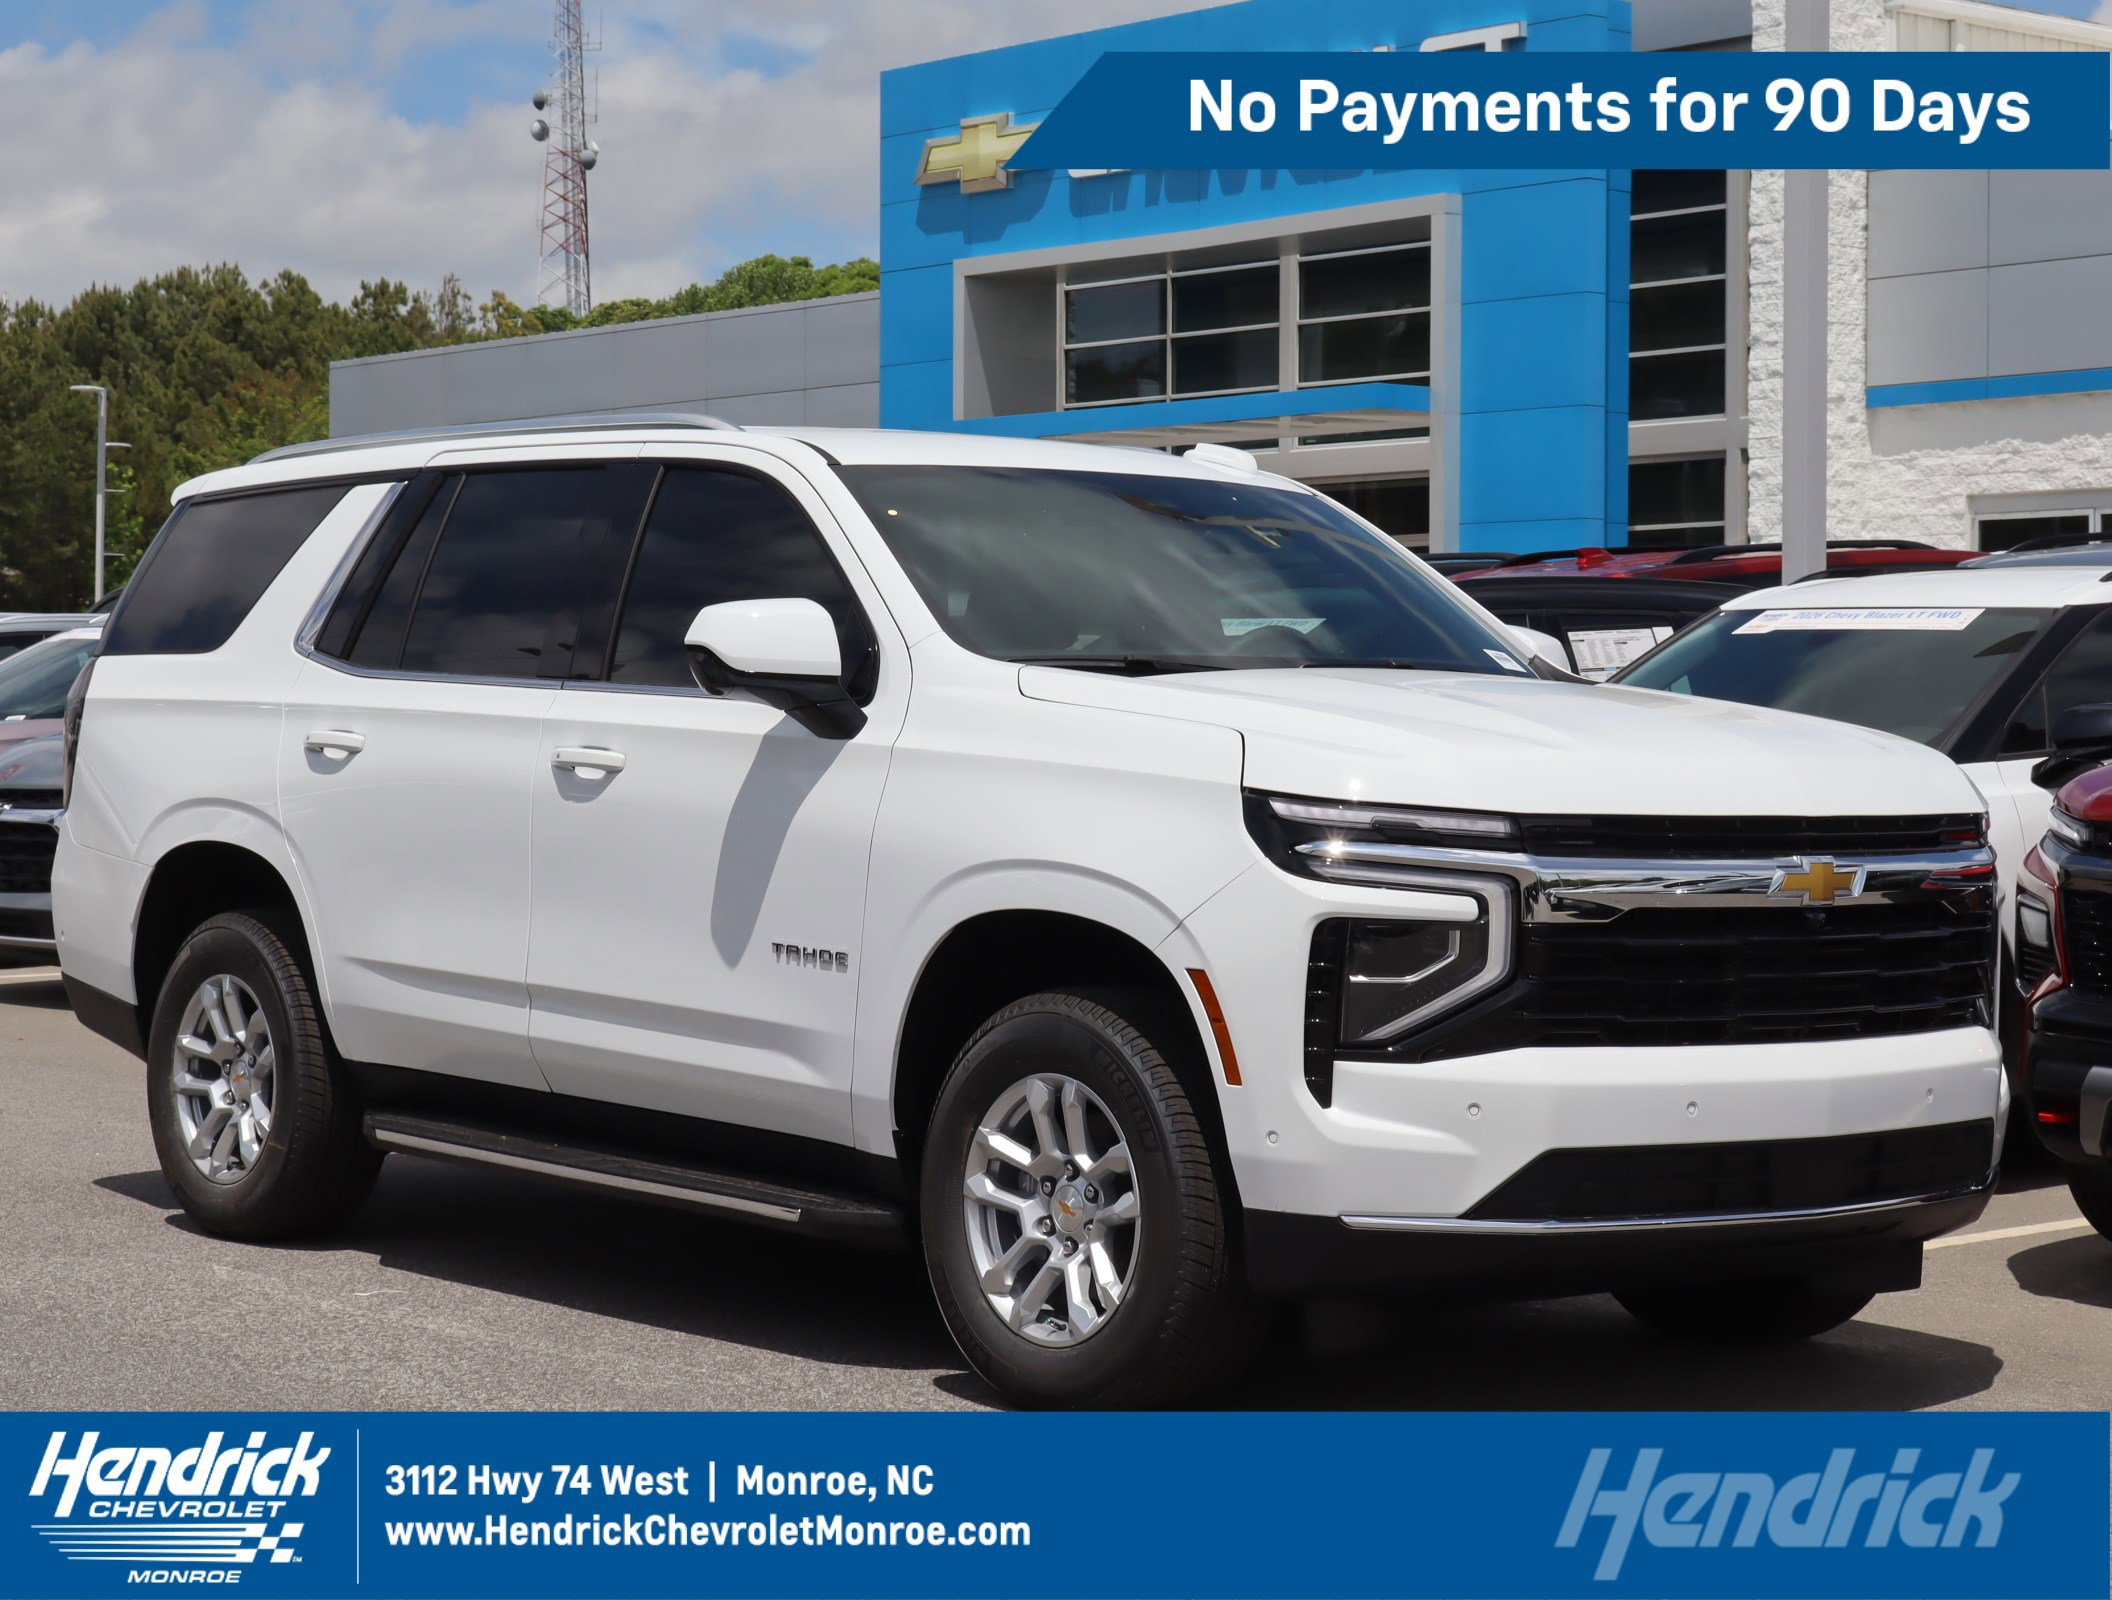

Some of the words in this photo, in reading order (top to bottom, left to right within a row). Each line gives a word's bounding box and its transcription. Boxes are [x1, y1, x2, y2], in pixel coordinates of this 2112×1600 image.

[1824, 611, 1862, 620] Chevy
[1863, 611, 1905, 619] Blazer
[1906, 611, 1927, 619] LT
[1927, 611, 1962, 619] FWD
[772, 942, 848, 970] TAHOE
